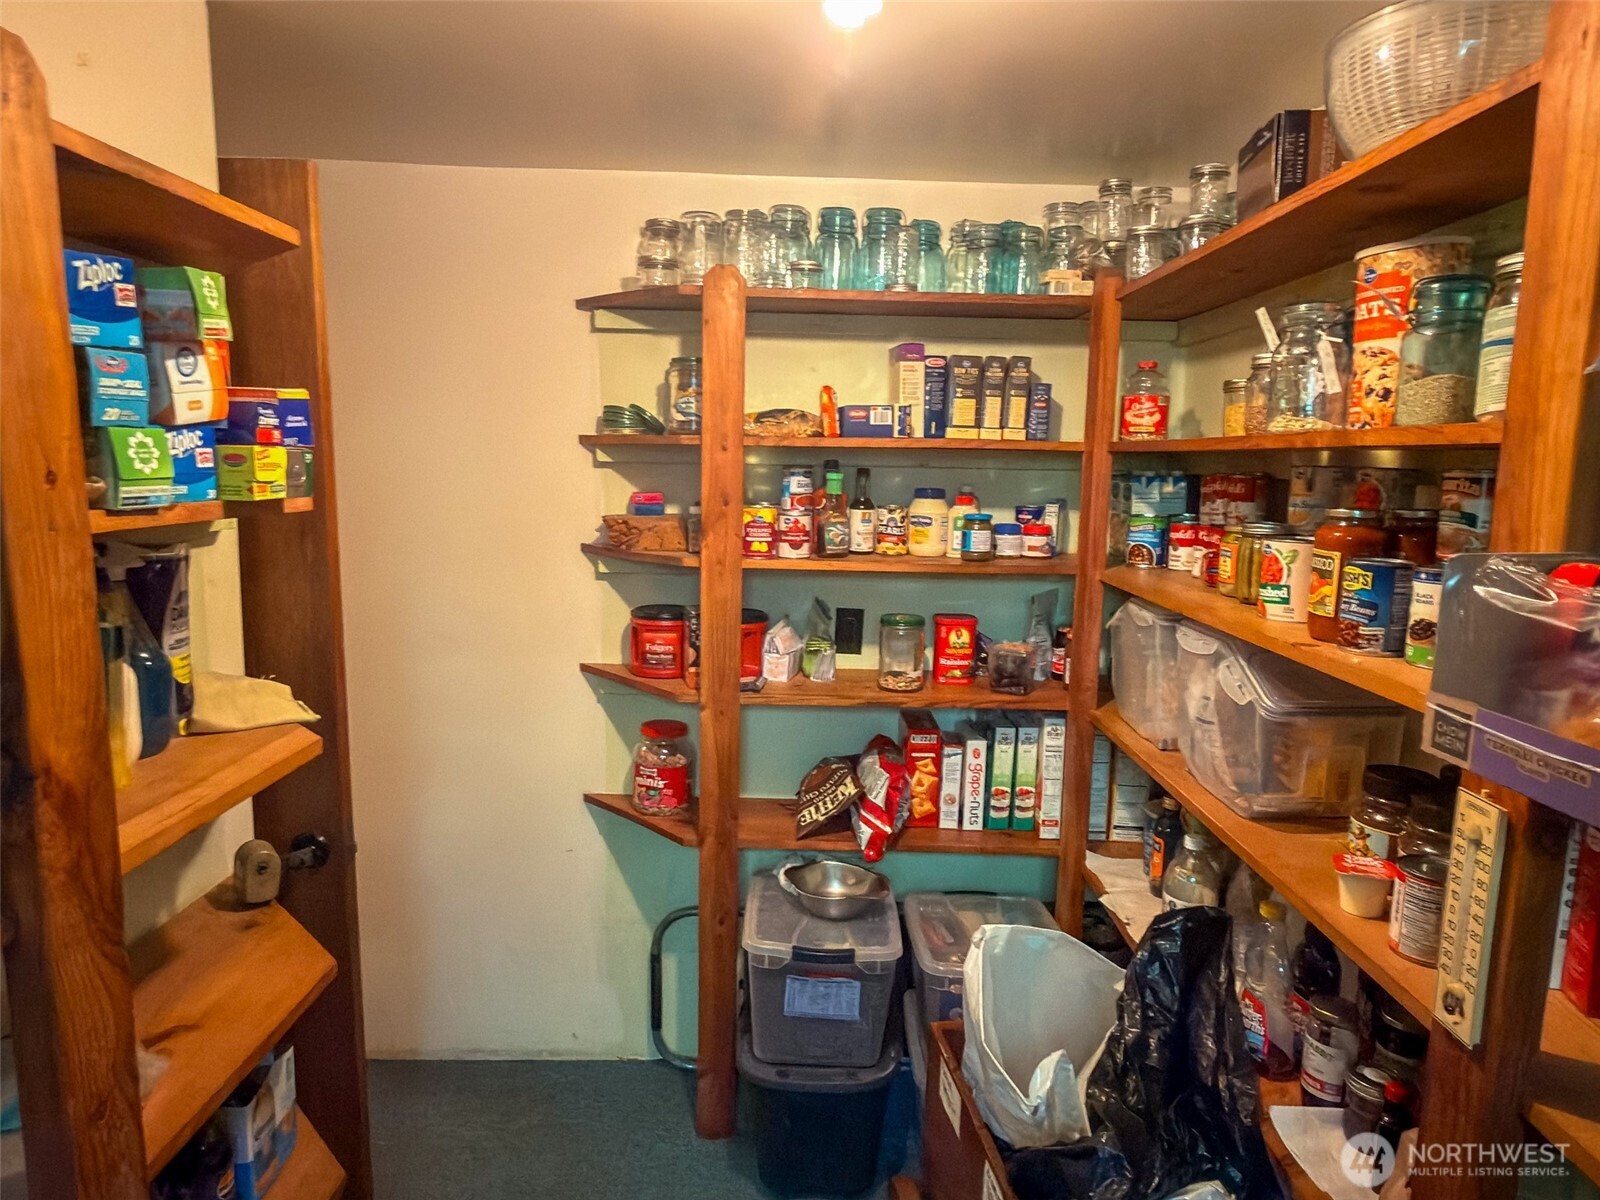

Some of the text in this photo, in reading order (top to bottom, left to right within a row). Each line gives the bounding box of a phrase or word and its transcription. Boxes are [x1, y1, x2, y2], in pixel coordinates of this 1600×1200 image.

[71, 257, 123, 292] Ziploc
[1355, 299, 1401, 320] ATS
[164, 429, 204, 459] Ziploc
[878, 525, 906, 535] PEARLS
[1258, 586, 1289, 599] shed
[645, 643, 674, 654] Folgers
[635, 775, 669, 789] minis
[798, 775, 860, 826] KETTLE
[967, 763, 983, 826] grape-nuts
